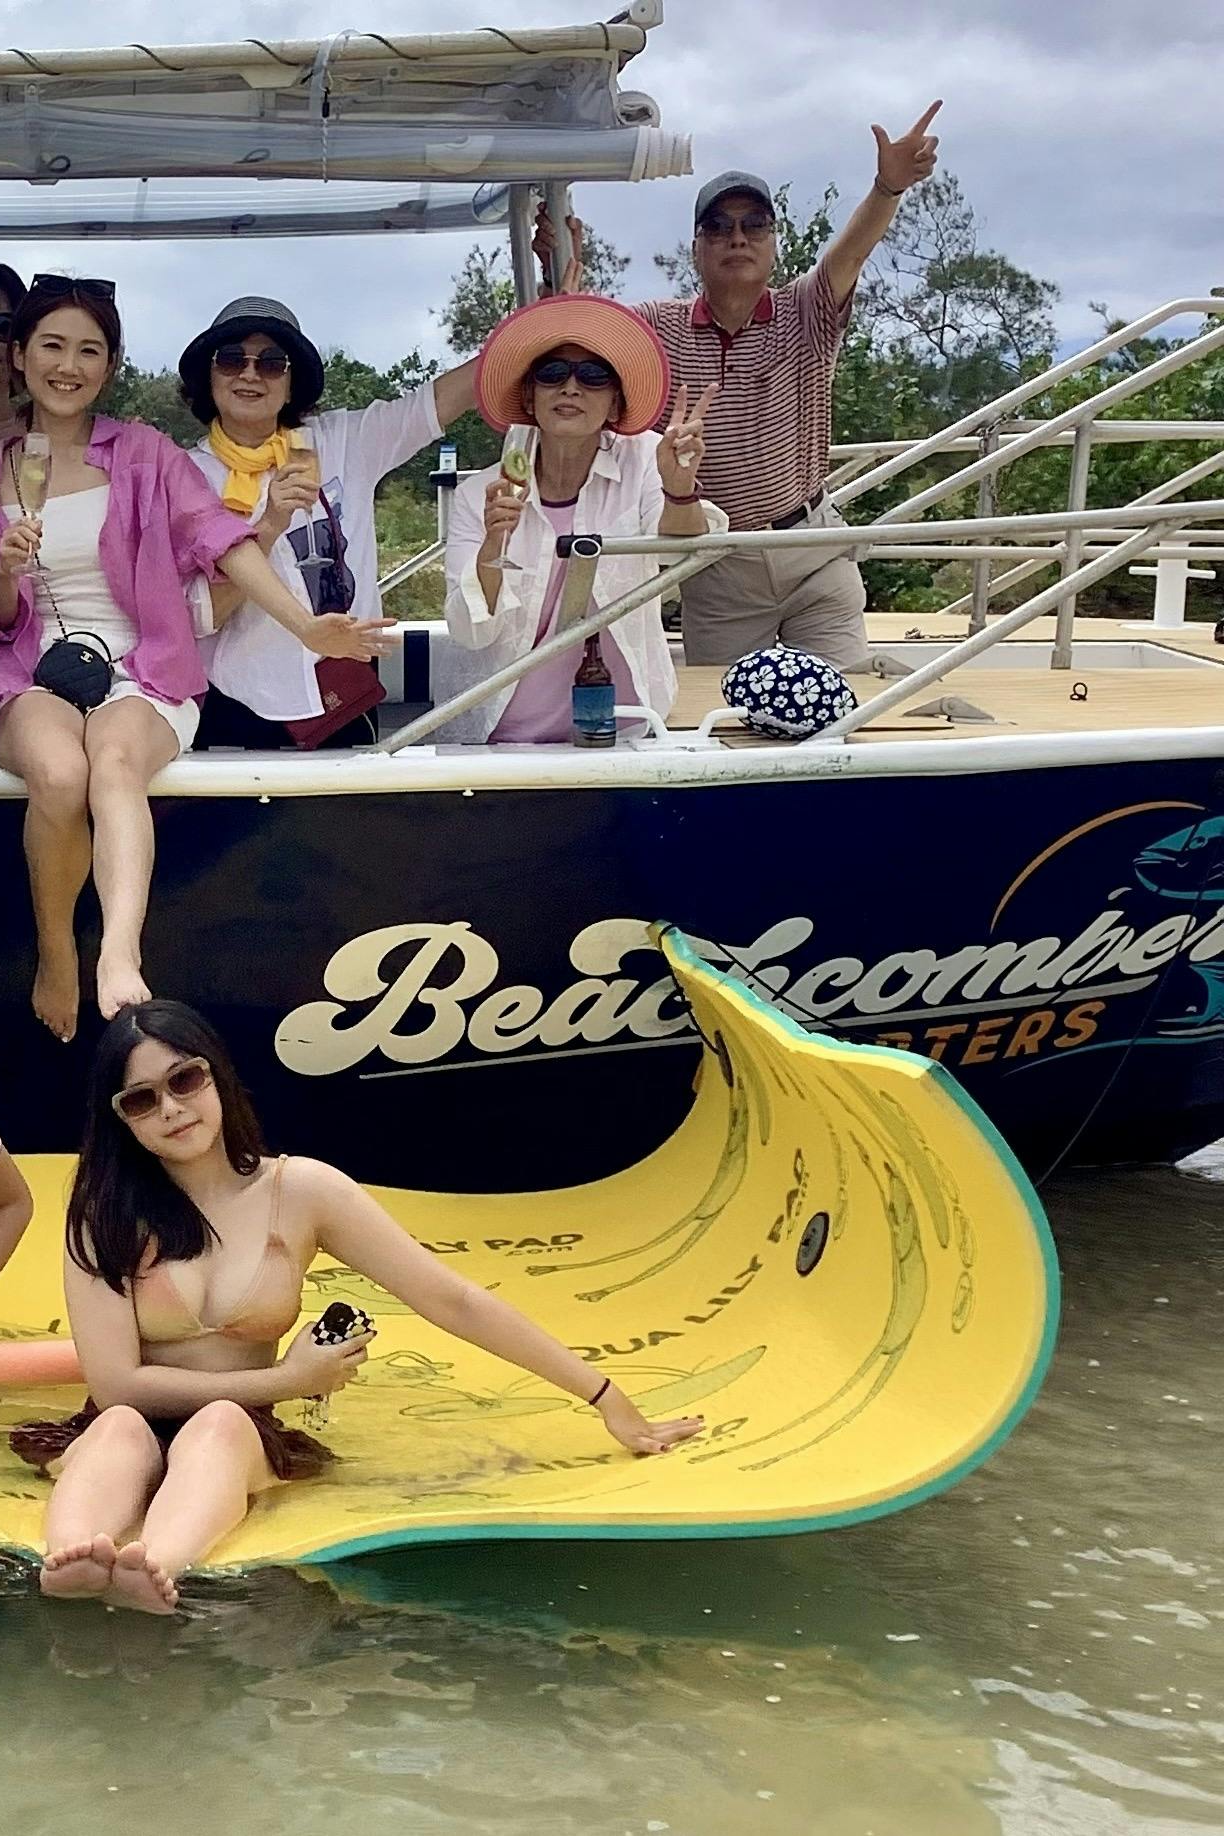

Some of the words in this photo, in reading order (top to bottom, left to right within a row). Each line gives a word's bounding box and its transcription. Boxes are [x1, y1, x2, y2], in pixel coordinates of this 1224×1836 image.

[483, 1234, 583, 1250] PAD
[567, 1330, 684, 1361] QUA
[683, 1254, 764, 1323] LILY
